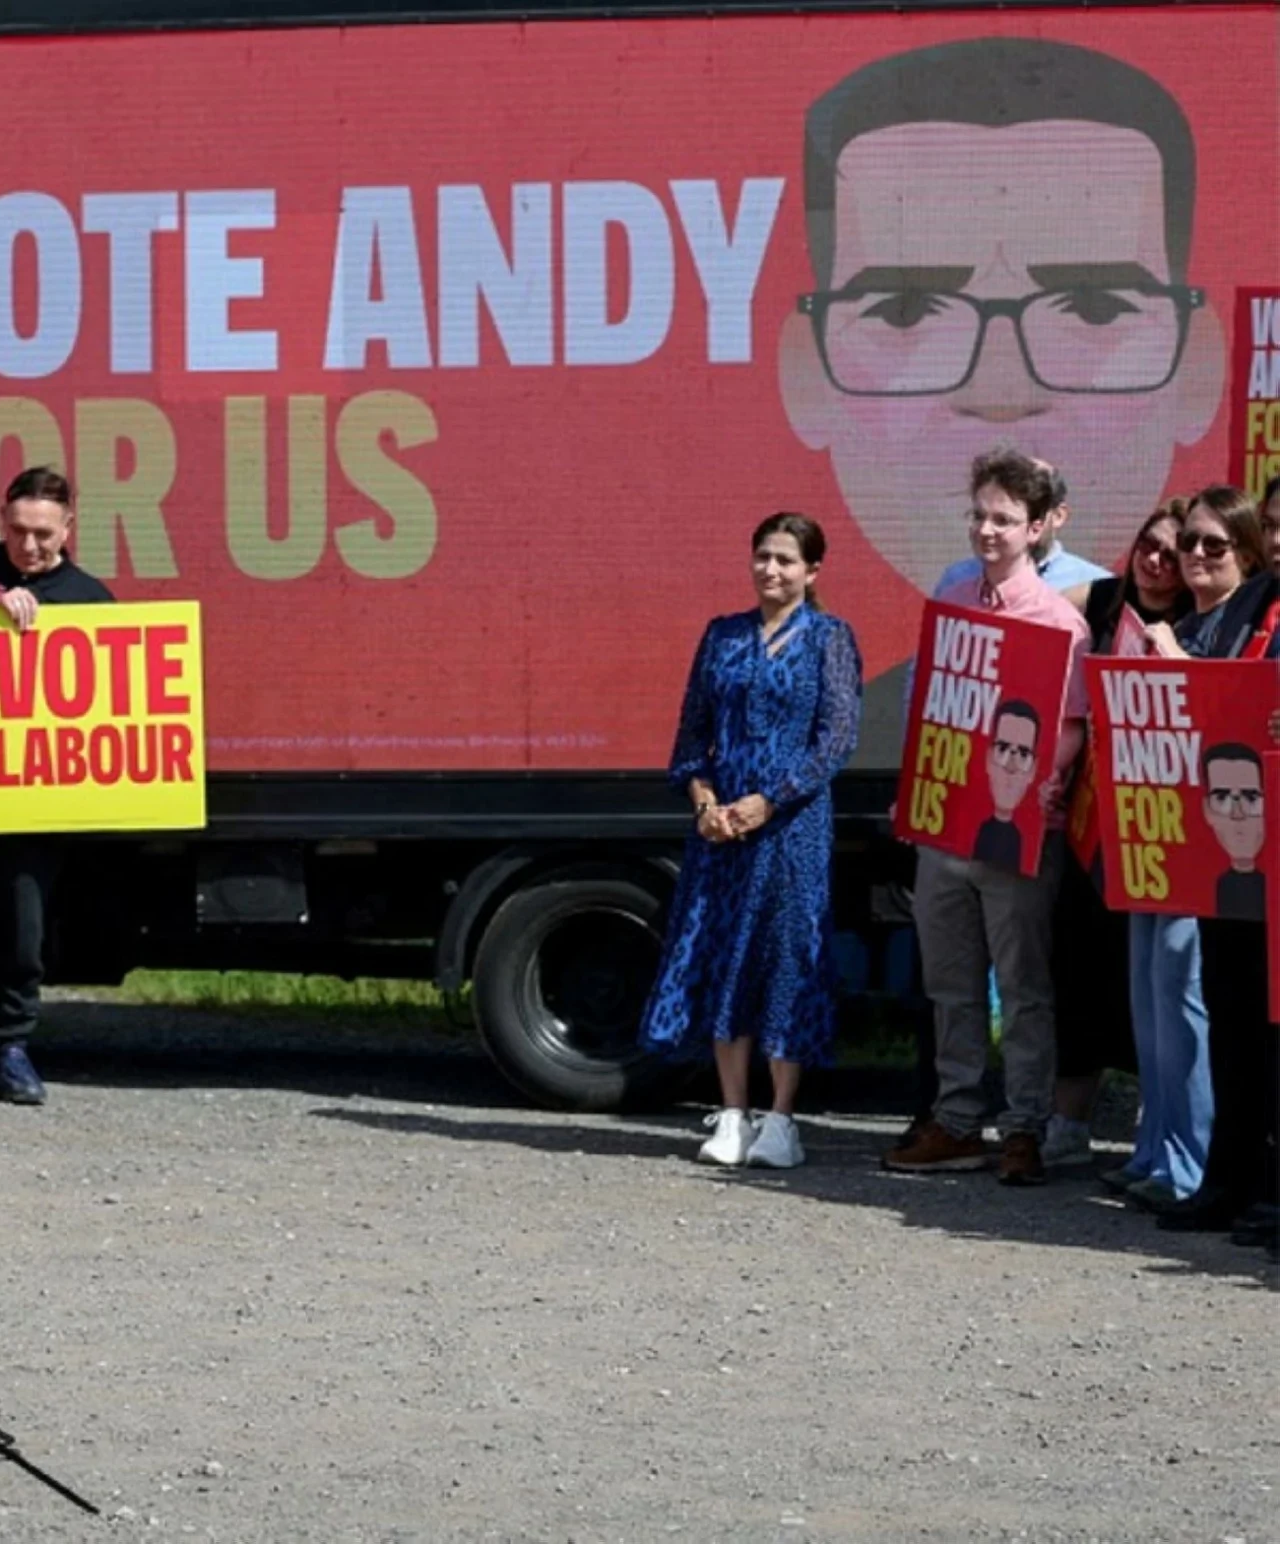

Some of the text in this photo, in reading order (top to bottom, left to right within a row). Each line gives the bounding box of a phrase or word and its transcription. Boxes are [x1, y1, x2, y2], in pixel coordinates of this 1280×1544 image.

[322, 178, 785, 370] ANDY
[1247, 402, 1280, 450] FO
[224, 390, 438, 580] US
[933, 614, 1004, 681] VOTE
[922, 669, 1002, 737] ANDY
[1100, 669, 1193, 729] VOTE
[916, 723, 972, 786] FOR
[1112, 729, 1202, 787] ANDY
[909, 778, 948, 836] US
[1115, 786, 1186, 844] FOR
[1122, 843, 1170, 900] US
